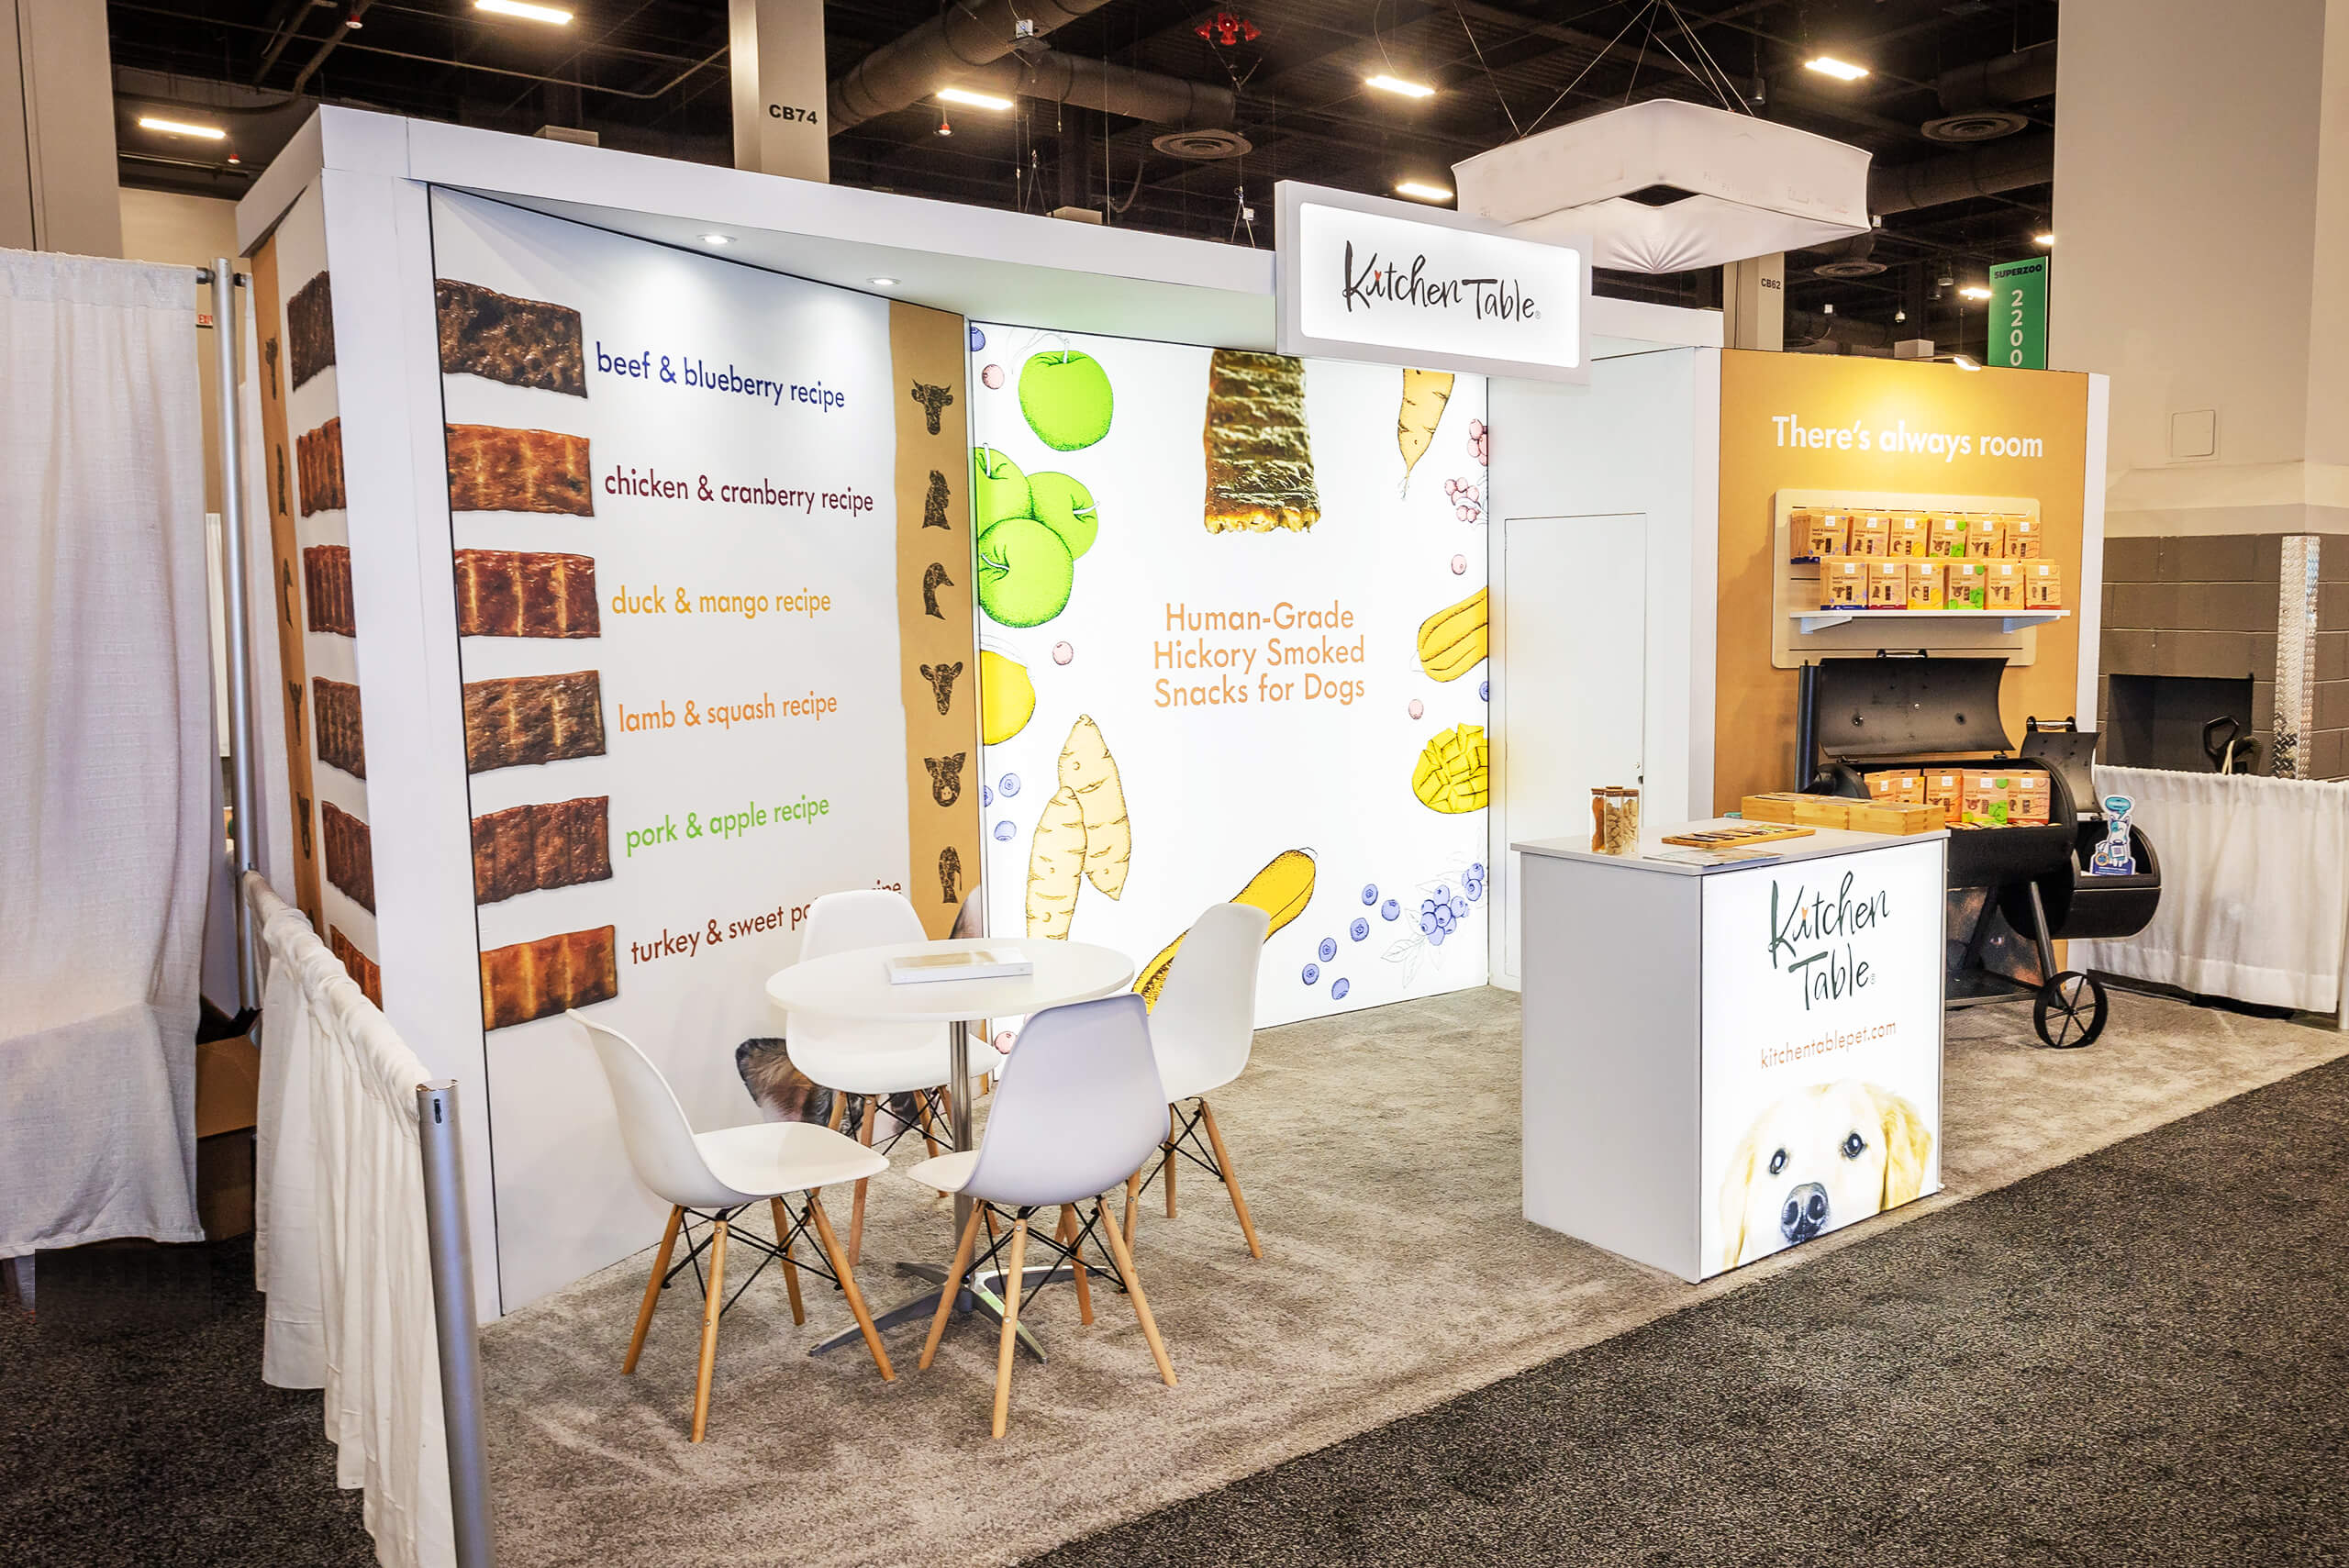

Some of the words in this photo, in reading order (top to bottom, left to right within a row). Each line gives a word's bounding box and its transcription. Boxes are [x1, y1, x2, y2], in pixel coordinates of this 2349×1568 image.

[769, 104, 818, 125] CB74
[1342, 240, 1463, 312] Kitchen
[1462, 278, 1535, 321] Table
[1761, 278, 1781, 290] CB62
[1994, 263, 2043, 279] SUPERZOO
[596, 340, 651, 379] beef
[659, 355, 677, 384] &
[684, 357, 783, 406] blueberry
[790, 381, 845, 413] recipe
[1772, 414, 1871, 450] There's
[1879, 419, 1972, 462] always
[1980, 436, 2043, 458] room
[605, 465, 689, 499] chicken
[697, 474, 714, 501] &
[720, 478, 815, 515] cranberry
[821, 486, 874, 517] recipe
[612, 584, 666, 614] duck
[674, 586, 692, 614] &
[699, 595, 768, 619] mango
[775, 587, 830, 618] recipe
[1166, 599, 1353, 631] Human-Grade
[1154, 638, 1257, 675] Hickory
[1266, 634, 1364, 666] Smoked
[618, 700, 675, 732] lamb
[684, 700, 701, 727] &
[707, 692, 775, 729] squash
[783, 691, 837, 721] recipe
[1154, 673, 1248, 707] Snacks
[1258, 673, 1295, 702] for
[1305, 673, 1364, 706] Dogs
[626, 814, 678, 857] pork
[686, 812, 703, 839] &
[709, 801, 767, 840] apple
[774, 795, 829, 825] recipe
[631, 929, 700, 964] turkey
[707, 918, 723, 946] &
[729, 906, 785, 939] sweet
[1767, 871, 1890, 969] Kitchen
[1787, 942, 1869, 1011] Table
[1761, 1021, 1897, 1069] kitchentablepet.com
